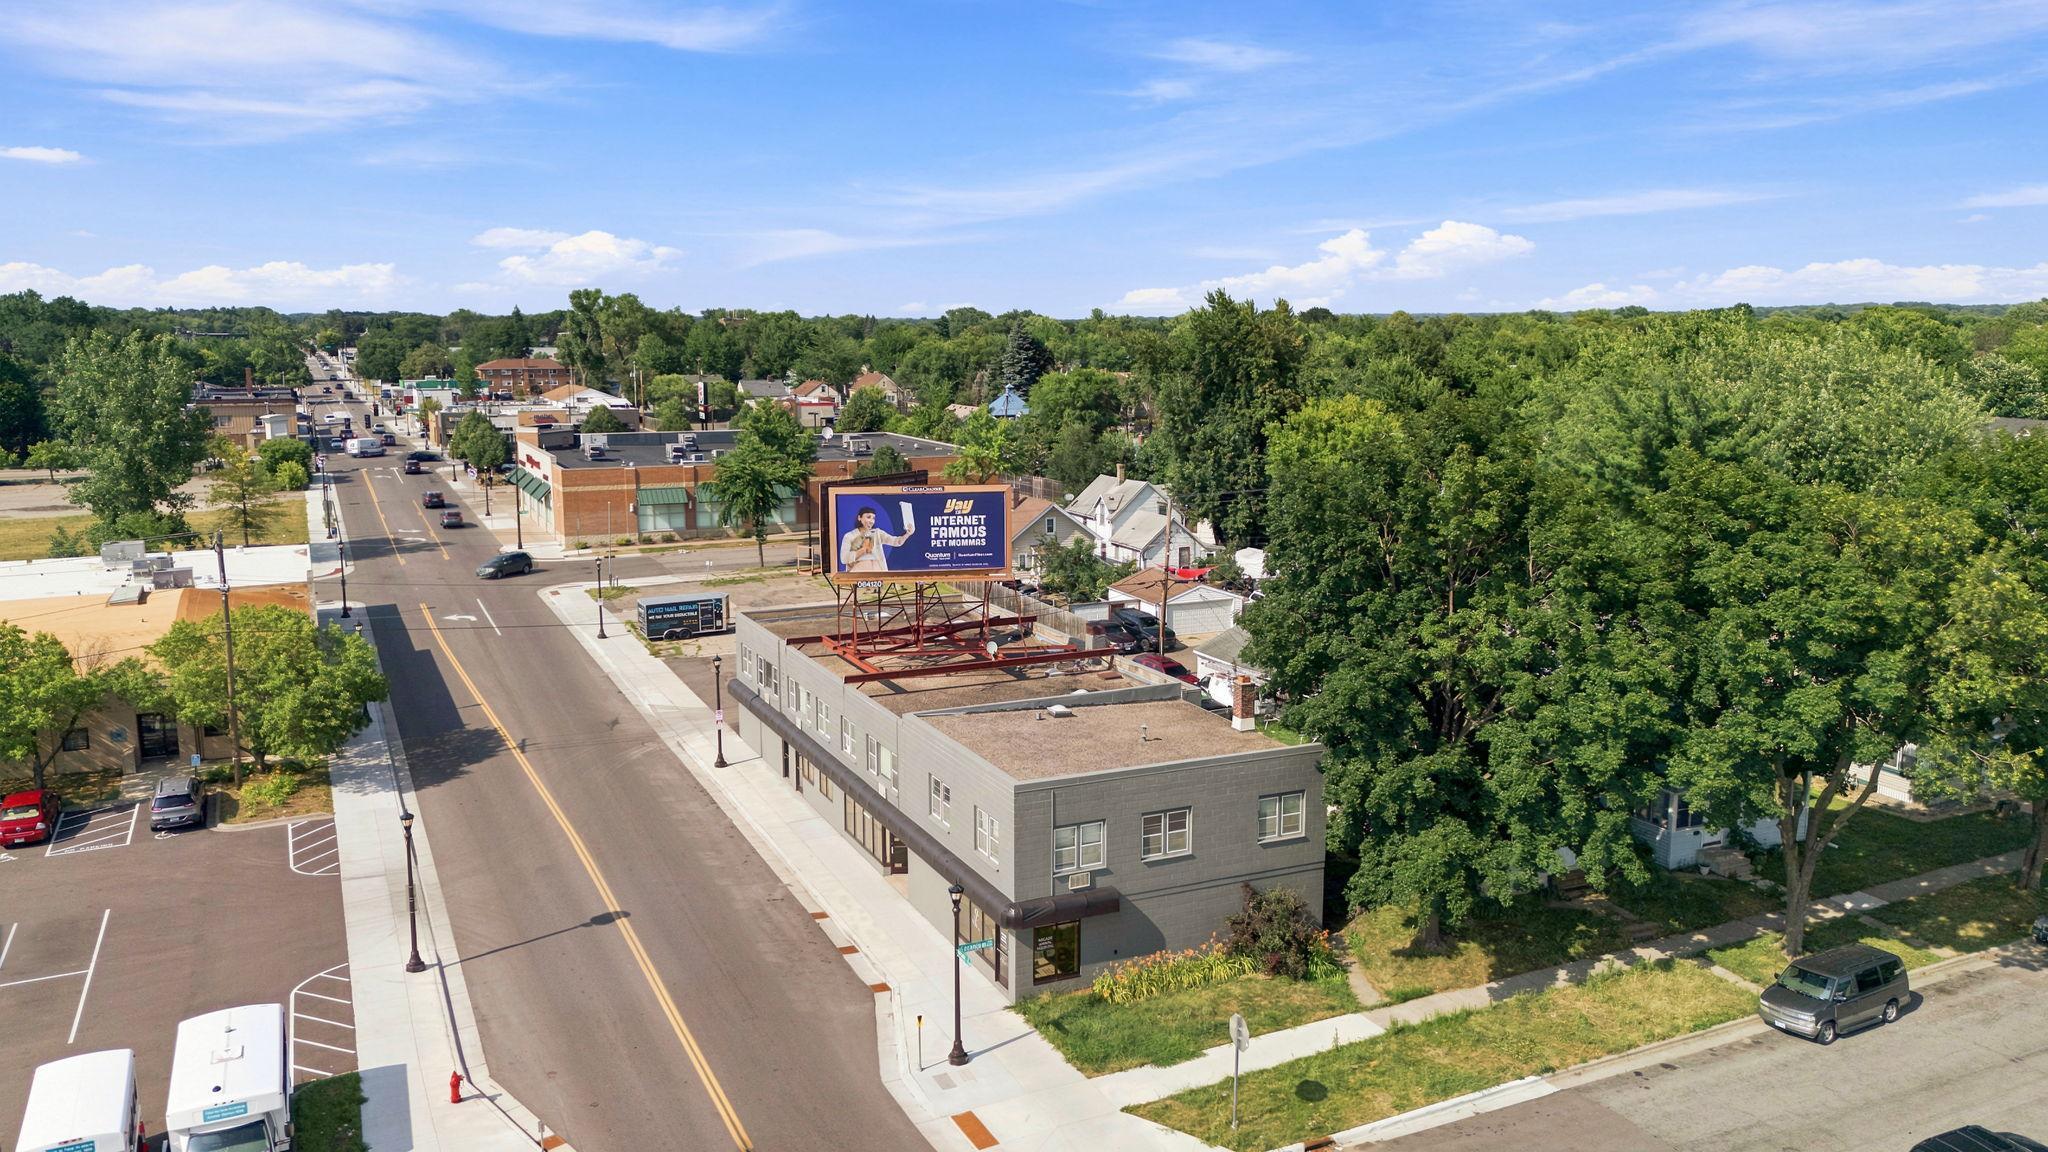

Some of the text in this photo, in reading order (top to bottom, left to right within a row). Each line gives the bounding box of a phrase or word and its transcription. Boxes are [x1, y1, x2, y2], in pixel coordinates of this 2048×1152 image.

[930, 515, 986, 526] INTERNET
[931, 526, 986, 538] FAMOUS
[948, 538, 986, 546] MOMMAS
